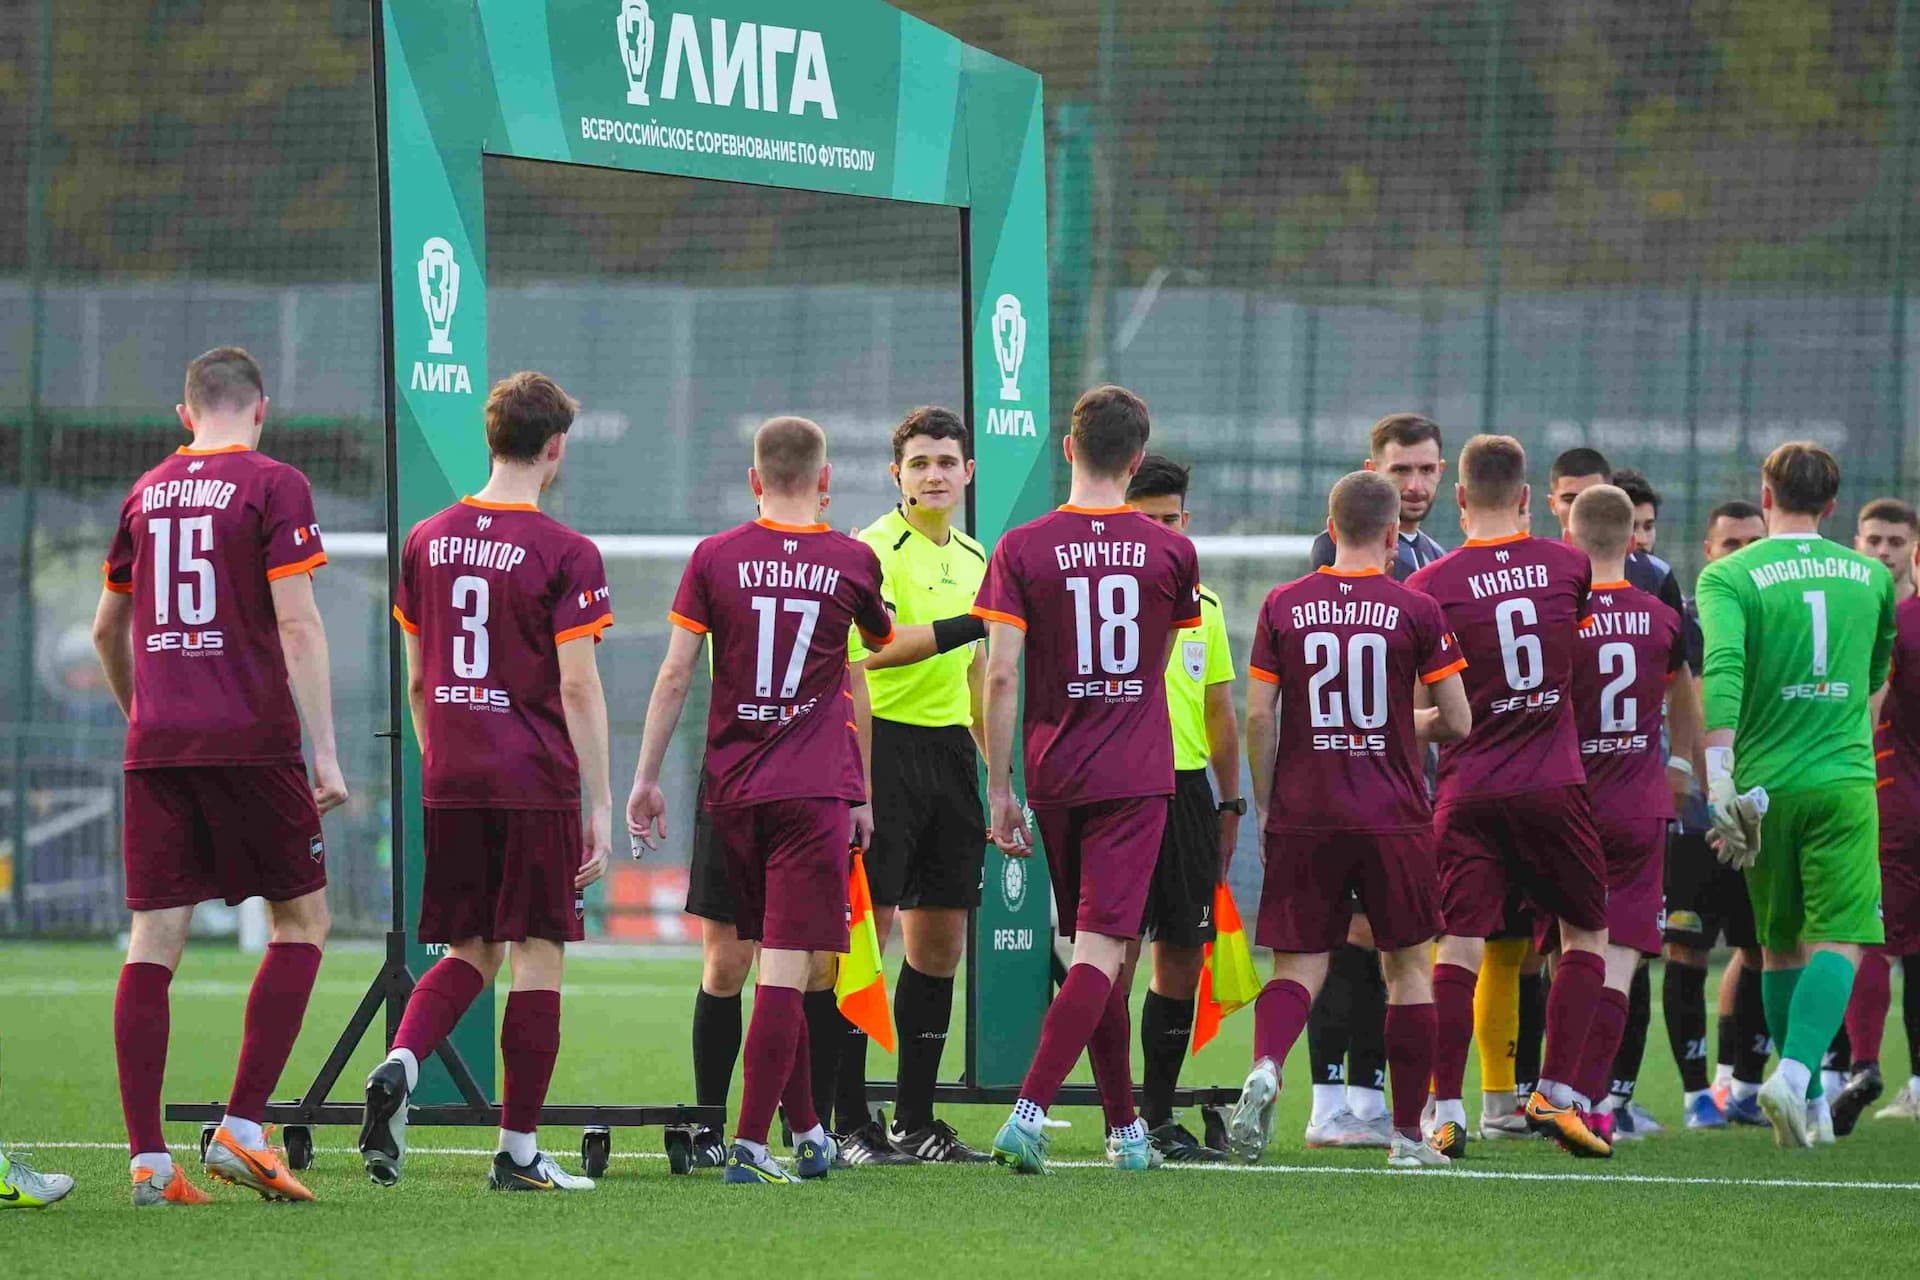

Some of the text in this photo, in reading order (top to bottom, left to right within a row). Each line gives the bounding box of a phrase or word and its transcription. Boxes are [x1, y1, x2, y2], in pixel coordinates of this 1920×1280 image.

[660, 12, 838, 119] ЛИГА
[581, 117, 875, 171] ВСЕРОССИЙСКОЕ СОРЕВНОВАНИЕ ПО ФУТБОЛУ
[411, 361, 472, 394] ЛИГА
[986, 408, 1037, 437] ЛИГА
[142, 479, 237, 514] АБРАМОВ
[148, 515, 217, 625] 15
[429, 536, 527, 572] ВЕРНИГОР
[1054, 541, 1146, 571] БРИЧЕЕВ
[738, 560, 840, 595] КУЗЬКИН
[1468, 564, 1549, 599] КНЯЗЕВ
[1749, 557, 1871, 590] МАСАЛЬСКИХ
[452, 575, 490, 679] 3
[1065, 574, 1140, 675] 18
[1291, 600, 1399, 631] ЗАВЬЯЛОВ
[1803, 590, 1828, 676] 1
[146, 631, 224, 652] SEUS
[751, 596, 821, 698] 17
[1495, 597, 1544, 691] 6
[434, 686, 510, 707] SEUS
[1067, 679, 1143, 698] SEUS
[1304, 631, 1388, 729] 20
[1599, 642, 1637, 732] 2
[1781, 682, 1850, 700] SEUS
[1490, 689, 1560, 713] SEUS
[1313, 734, 1386, 750] SEUS
[1581, 734, 1648, 754] SEUS
[994, 929, 1033, 950] RFS.RU
